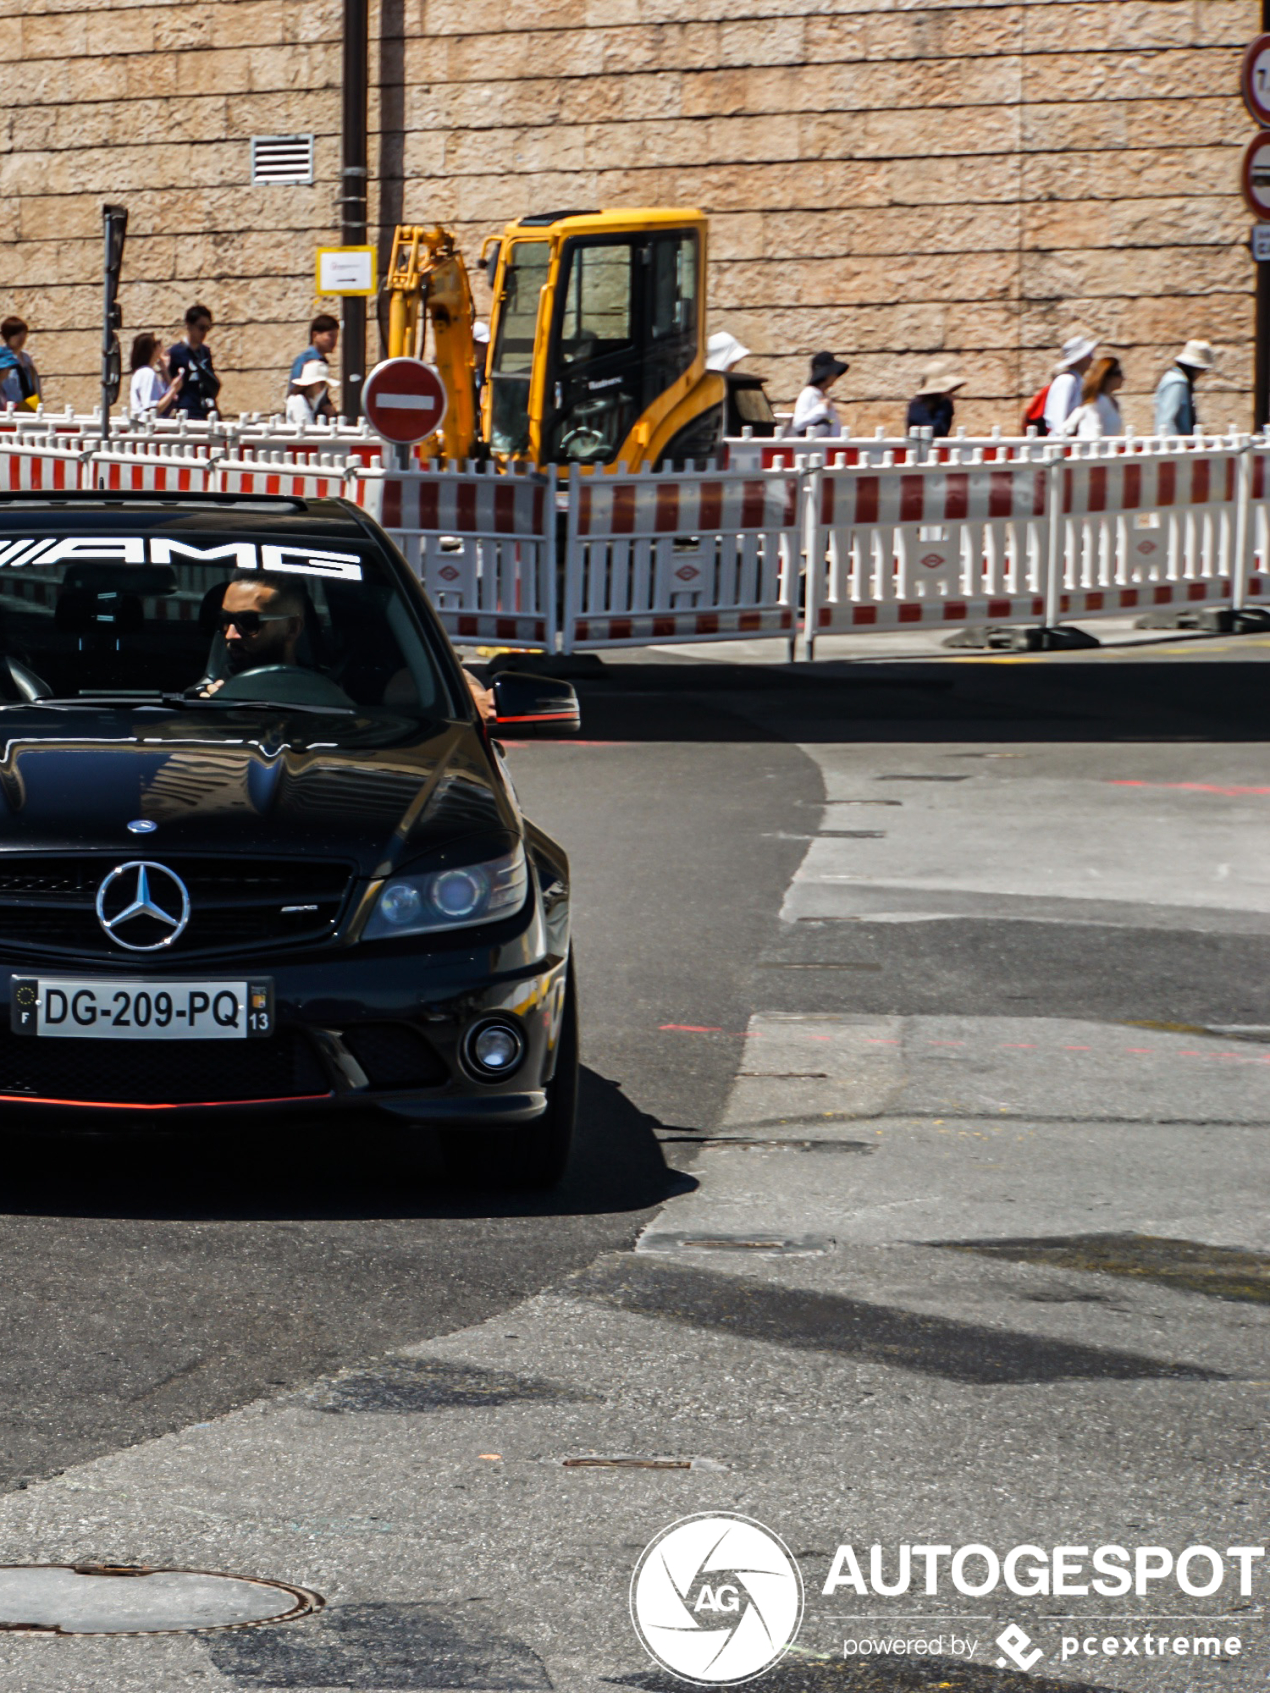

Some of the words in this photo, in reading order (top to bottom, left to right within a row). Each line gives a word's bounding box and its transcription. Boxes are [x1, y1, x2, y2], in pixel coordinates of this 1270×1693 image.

[32, 537, 363, 581] AMG
[21, 1012, 30, 1024] F
[45, 988, 239, 1029] DG-209-PQ
[249, 1012, 269, 1030] 13
